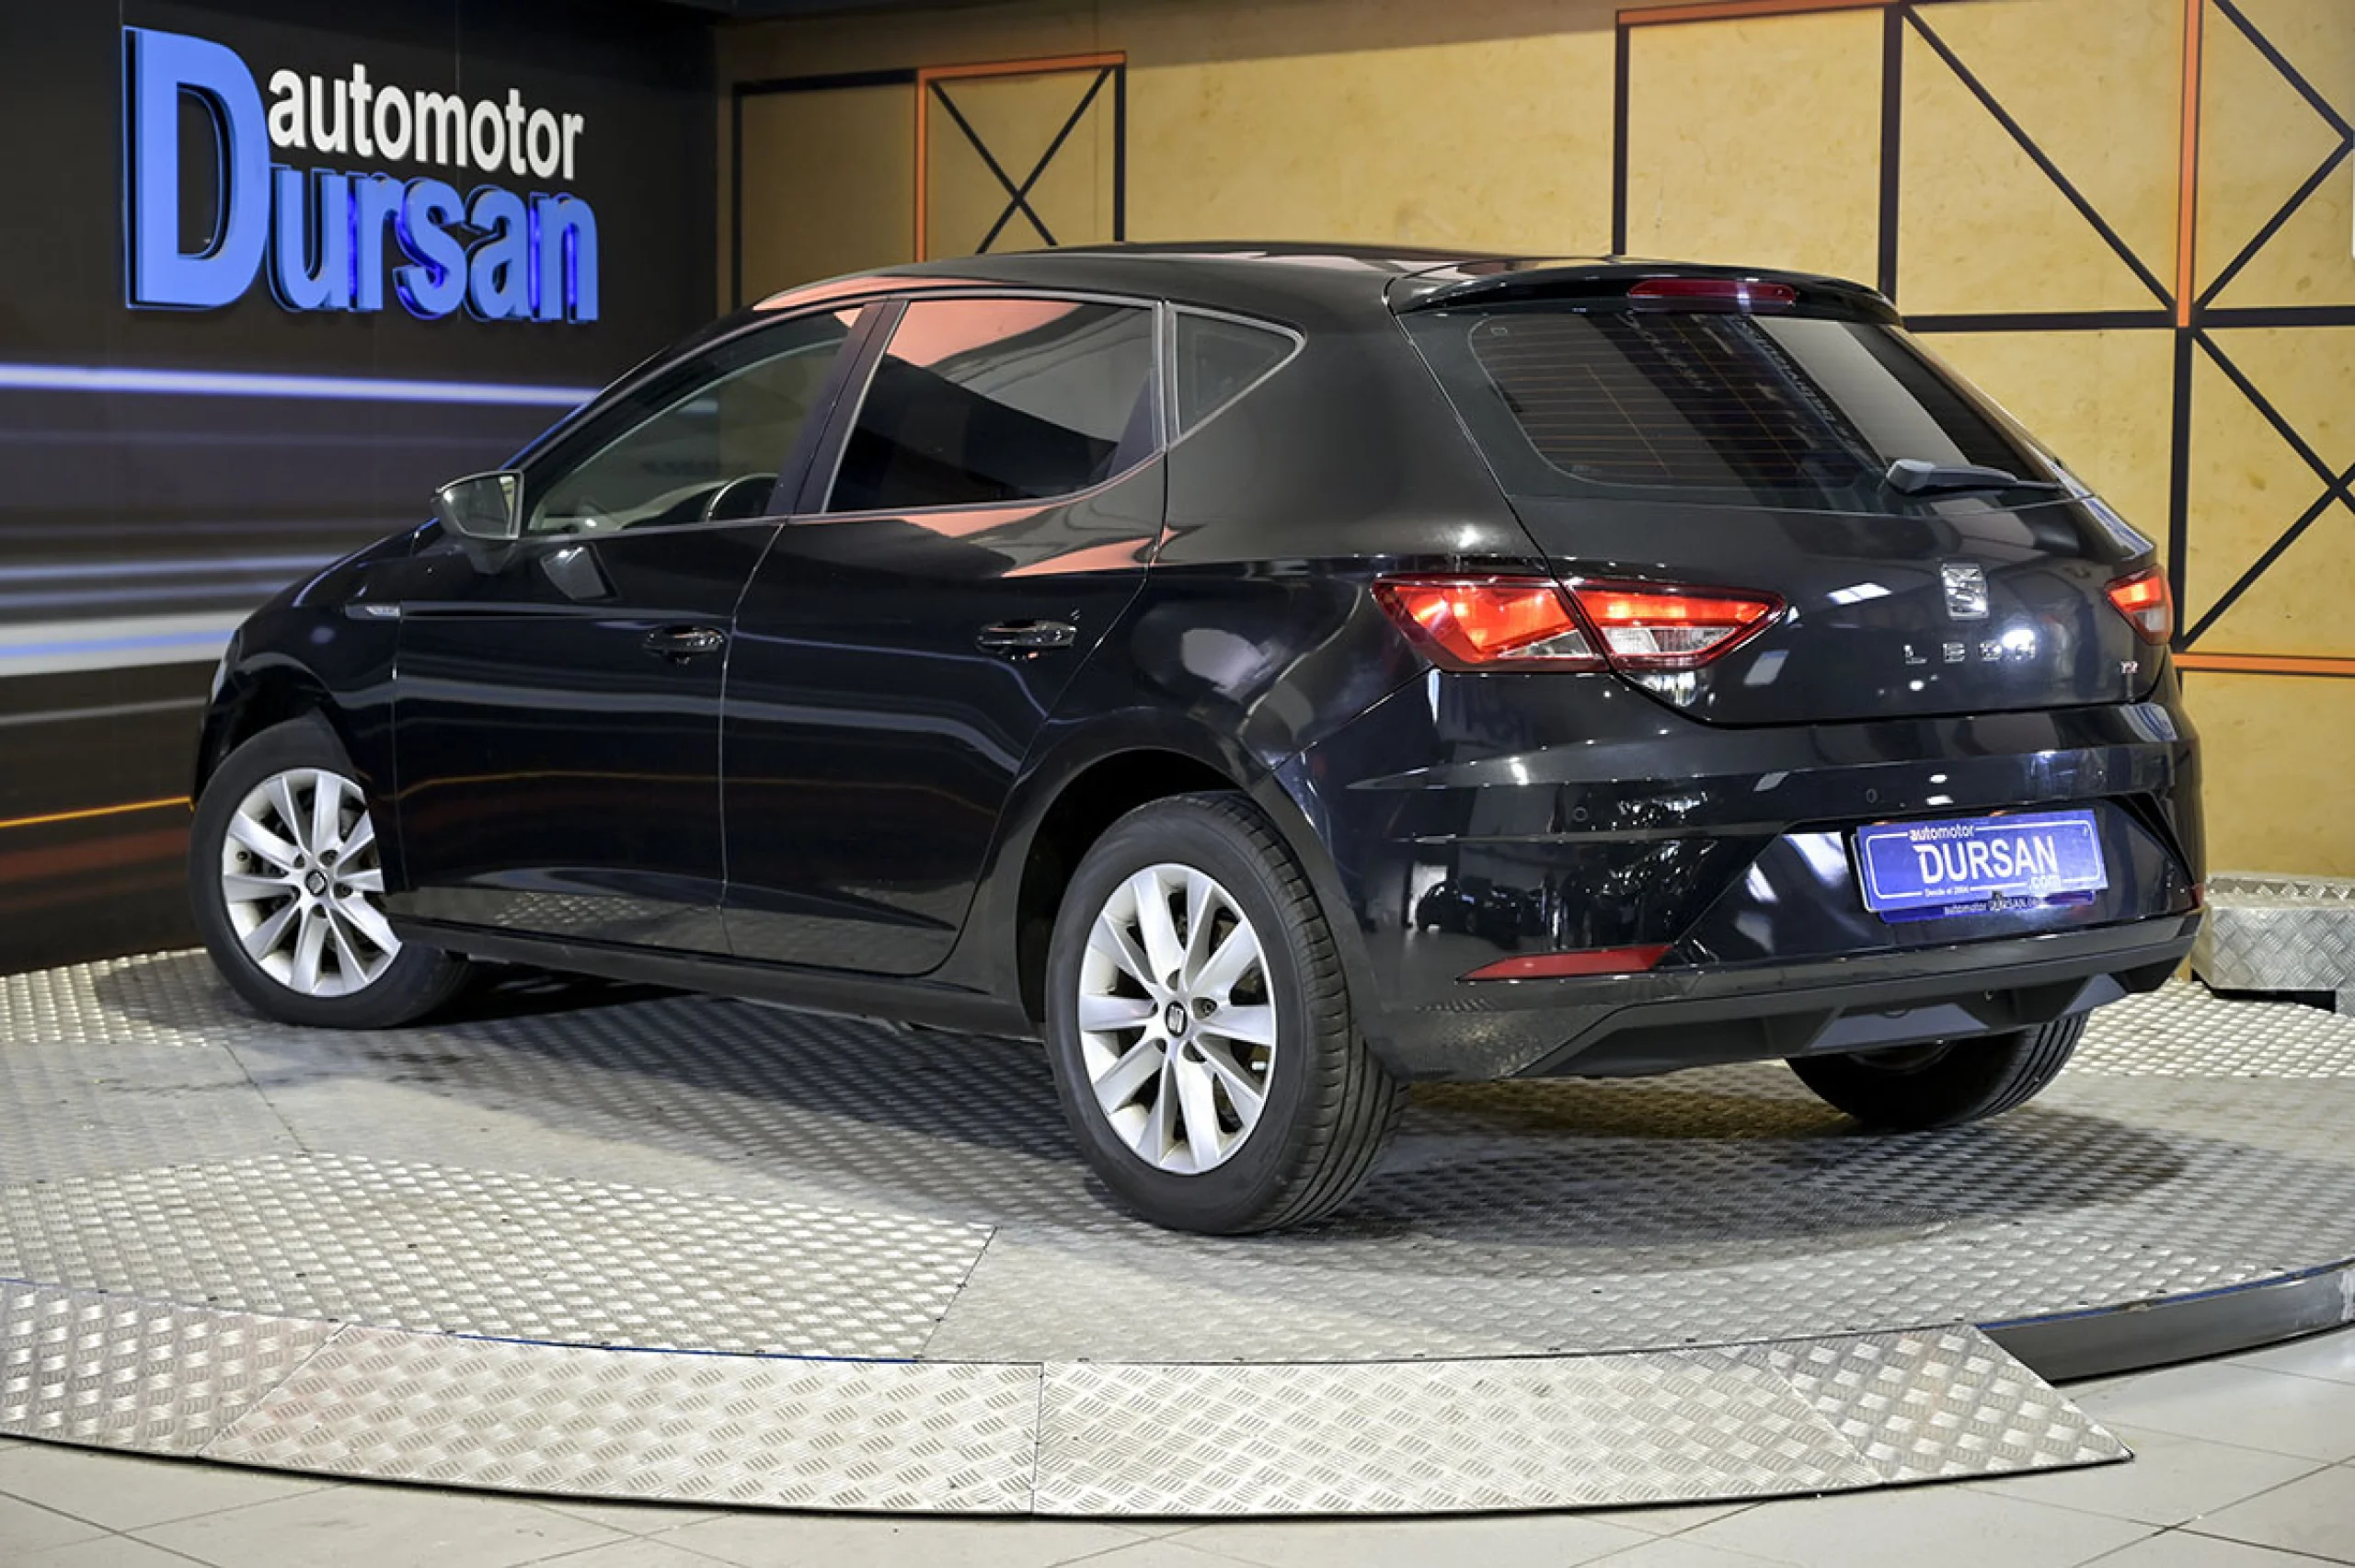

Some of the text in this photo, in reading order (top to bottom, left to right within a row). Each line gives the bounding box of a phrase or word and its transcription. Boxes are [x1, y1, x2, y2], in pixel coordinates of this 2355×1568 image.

[268, 63, 584, 179] automotor
[122, 25, 599, 323] Dursan
[1909, 823, 1974, 841] automotor
[1913, 835, 2059, 884] DURSAN
